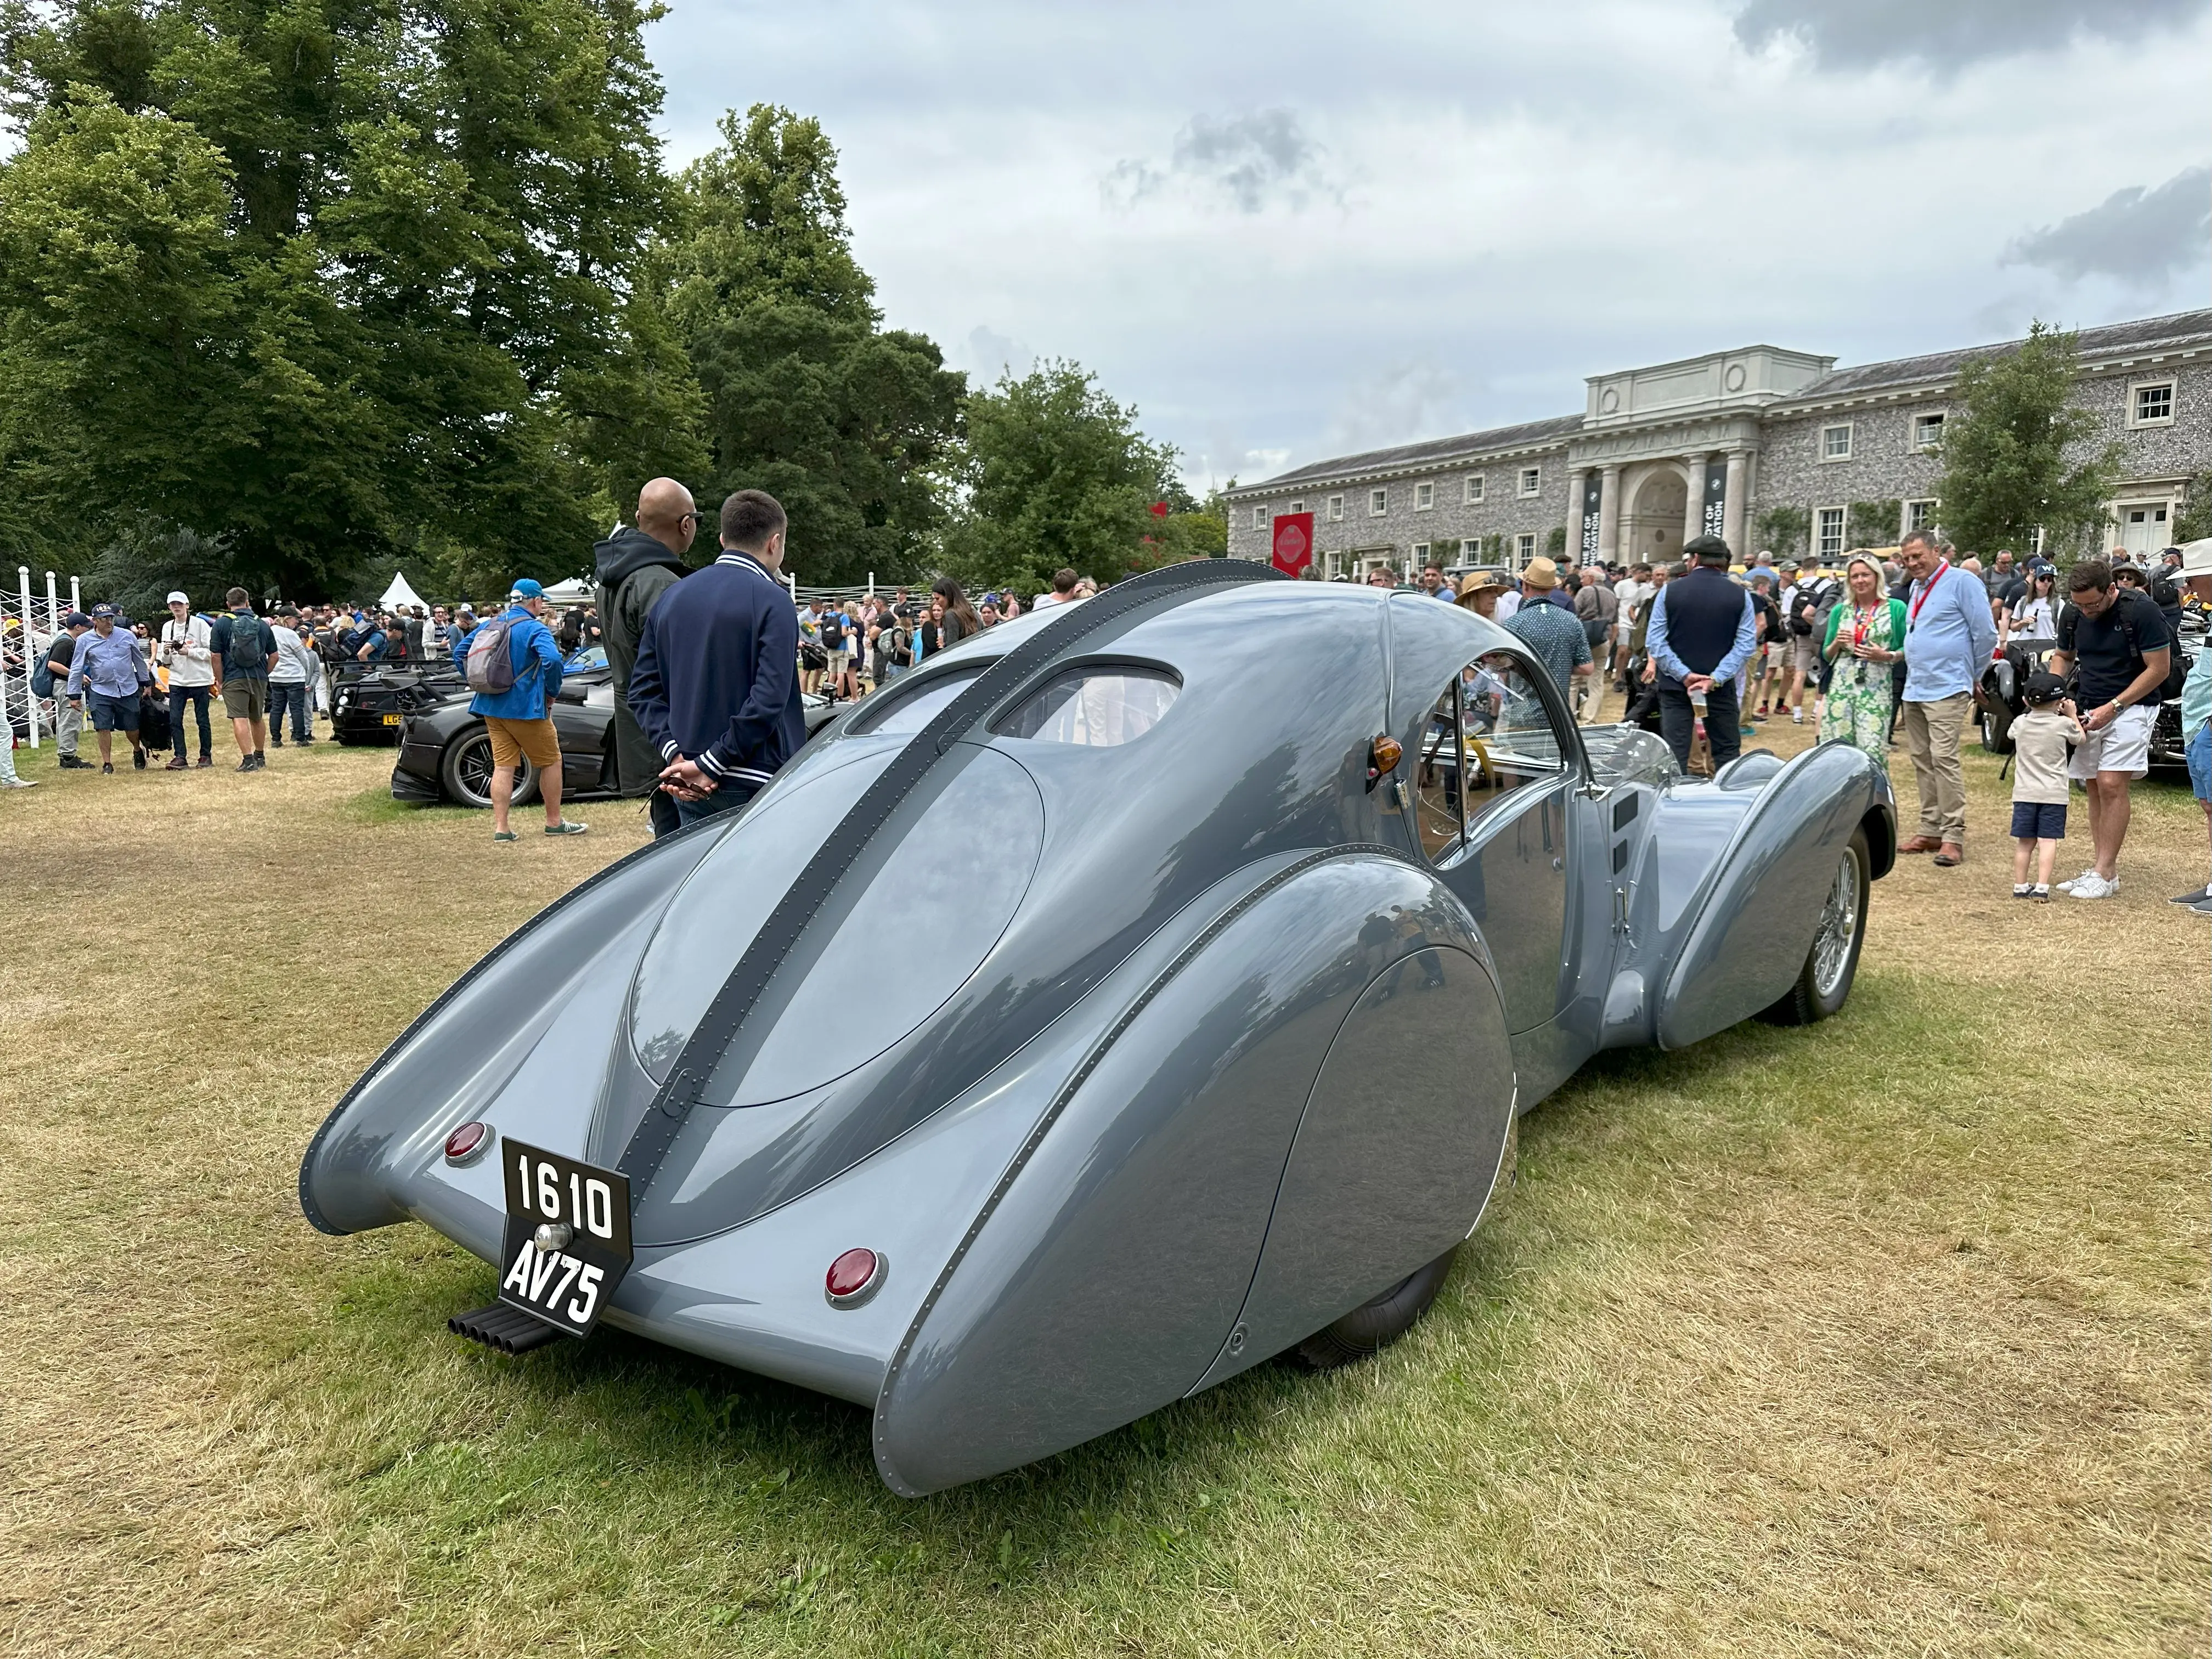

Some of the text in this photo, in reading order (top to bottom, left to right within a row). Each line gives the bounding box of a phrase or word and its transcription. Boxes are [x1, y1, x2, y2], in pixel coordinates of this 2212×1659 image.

[1584, 515, 1592, 529] OF
[1704, 505, 1714, 535] OY OF
[1583, 531, 1591, 549] JOY
[518, 1154, 612, 1239] 1610
[503, 1239, 604, 1323] AV75
